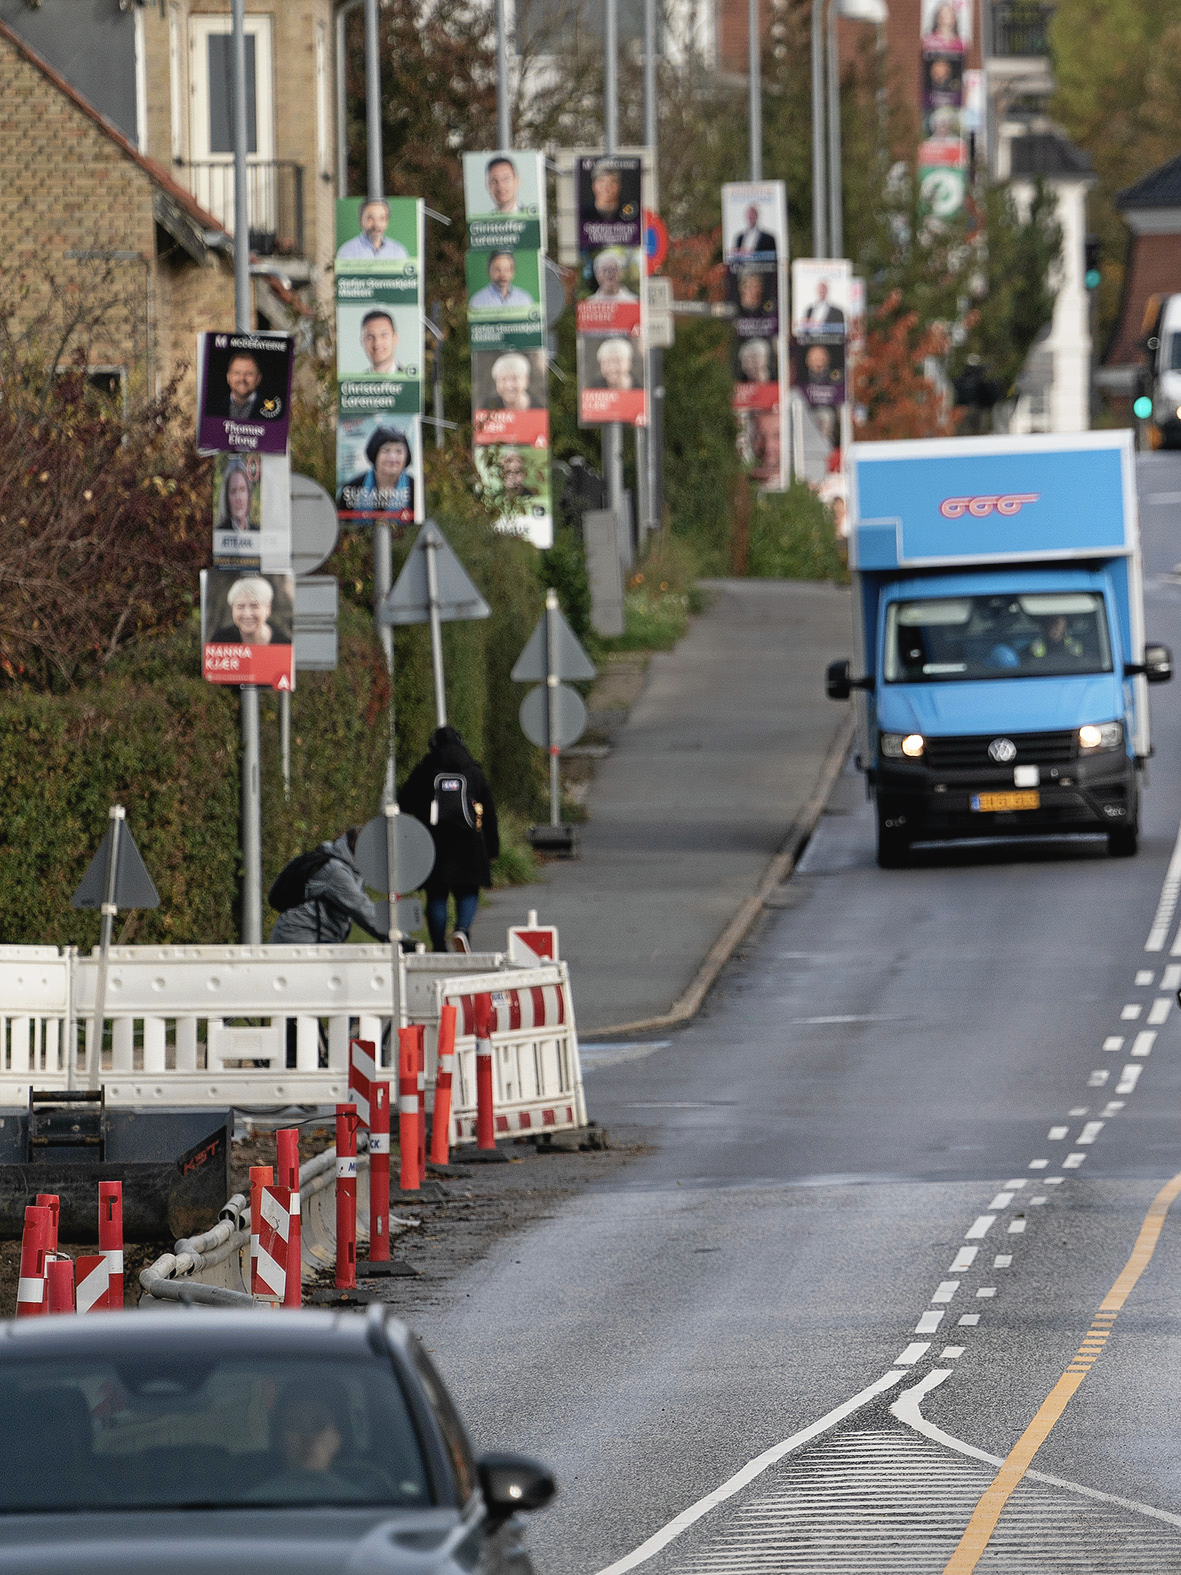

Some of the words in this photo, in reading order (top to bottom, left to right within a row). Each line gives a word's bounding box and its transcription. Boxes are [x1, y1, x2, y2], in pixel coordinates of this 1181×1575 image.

[341, 381, 404, 395] Christoffer
[341, 395, 396, 408] Lorenzen
[223, 420, 266, 437] Thomas
[342, 485, 411, 502] SUSANNE
[205, 644, 252, 659] NANNA
[205, 656, 240, 671] KJÆR
